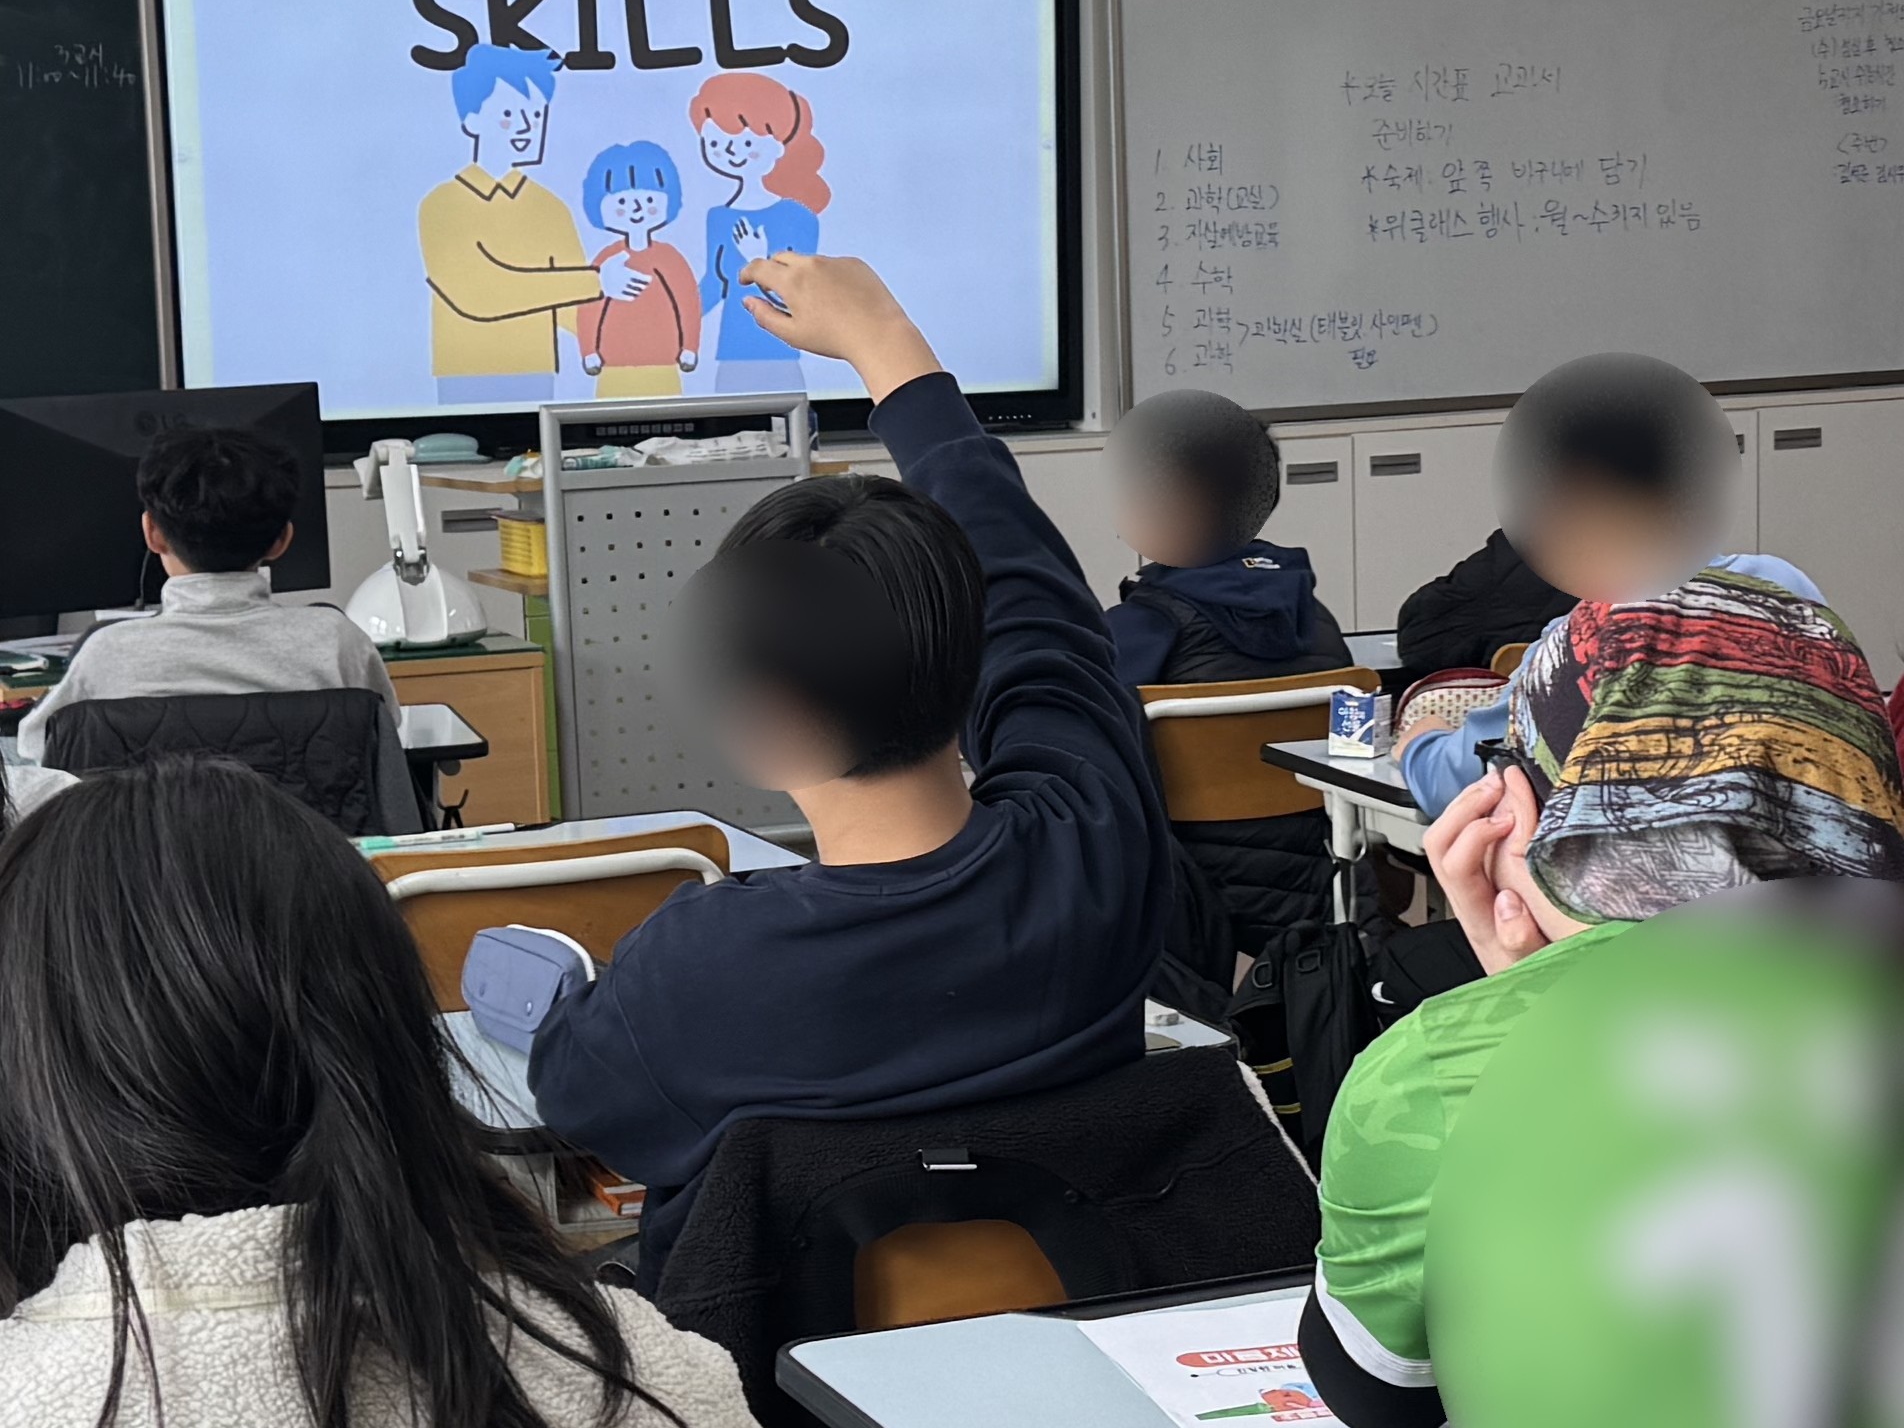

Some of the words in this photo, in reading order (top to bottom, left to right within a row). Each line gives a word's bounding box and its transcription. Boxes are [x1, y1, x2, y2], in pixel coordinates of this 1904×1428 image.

[1412, 65, 1471, 102] 시간표
[1371, 118, 1453, 151] 준비하기
[1184, 143, 1223, 175] 사회
[1597, 151, 1647, 189] 담기
[1190, 260, 1233, 295] 수학
